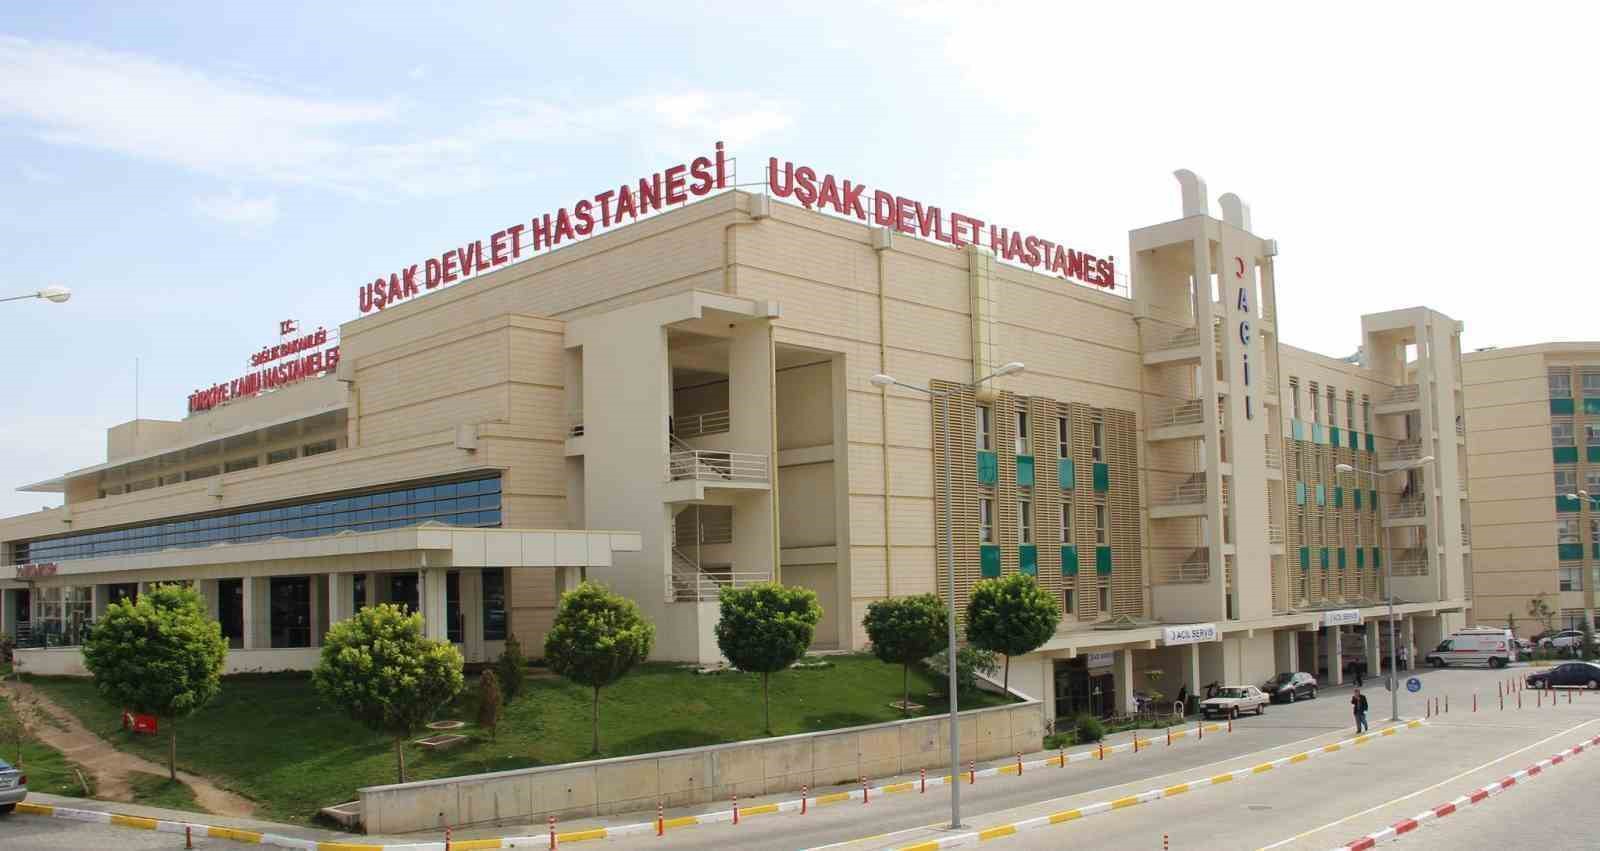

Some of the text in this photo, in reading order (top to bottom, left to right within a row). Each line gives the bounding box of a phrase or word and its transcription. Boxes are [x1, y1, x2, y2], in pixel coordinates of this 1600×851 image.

[359, 141, 726, 312] UŞAK DEVLET HASTANESİ
[769, 157, 1115, 290] UŞAK DEVLET HASTANESİ
